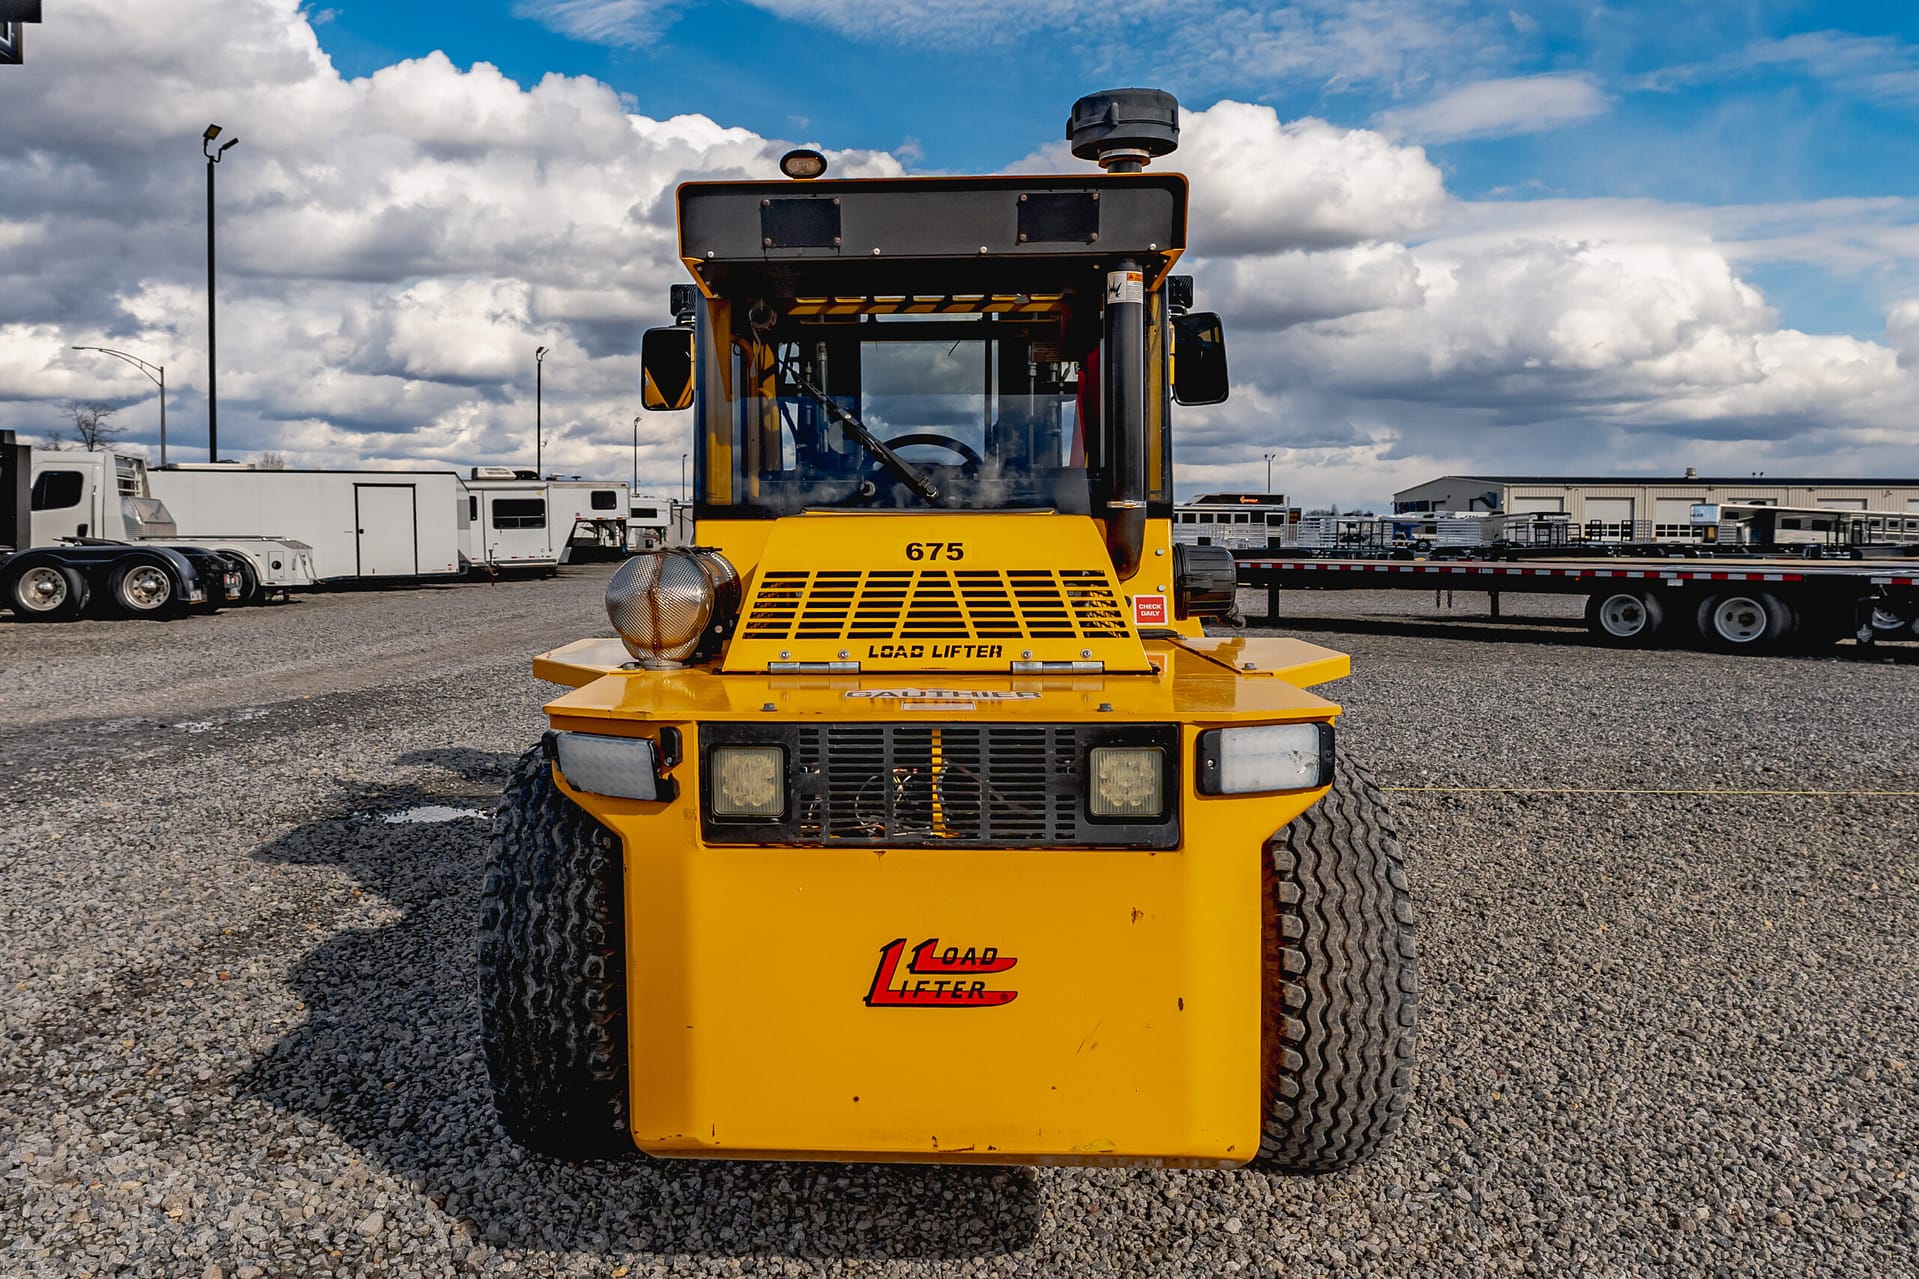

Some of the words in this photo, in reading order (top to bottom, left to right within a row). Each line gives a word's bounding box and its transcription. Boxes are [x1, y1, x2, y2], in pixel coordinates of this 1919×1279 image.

[905, 542, 964, 561] 675
[868, 645, 924, 658] LOAD
[932, 645, 1003, 658] LIFTER
